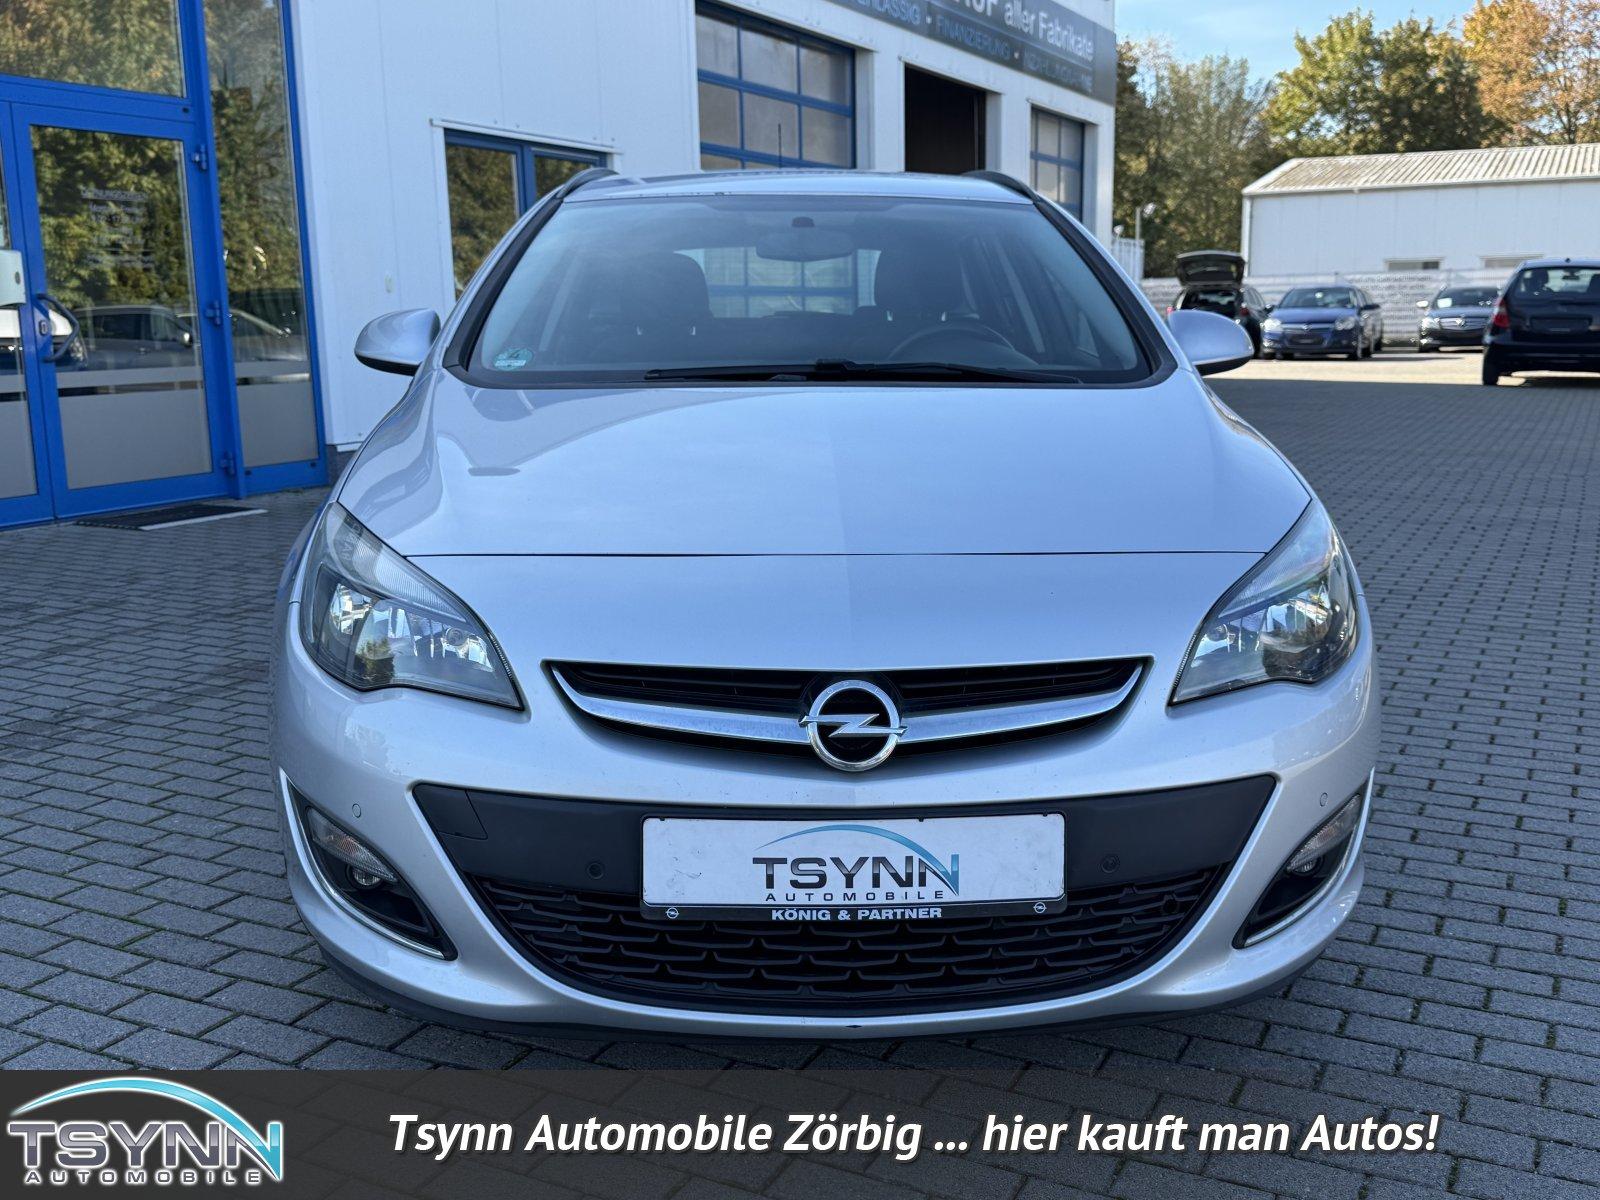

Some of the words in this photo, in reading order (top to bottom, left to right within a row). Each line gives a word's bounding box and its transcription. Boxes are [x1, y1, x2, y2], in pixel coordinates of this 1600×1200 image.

[1003, 0, 1036, 36] aller
[1038, 11, 1094, 62] Fabrikate
[752, 853, 960, 896] TSYNN
[765, 890, 944, 902] AUTOMOBILE
[771, 907, 831, 921] KÖNIG
[837, 908, 851, 921] &
[857, 907, 942, 920] PARTNER
